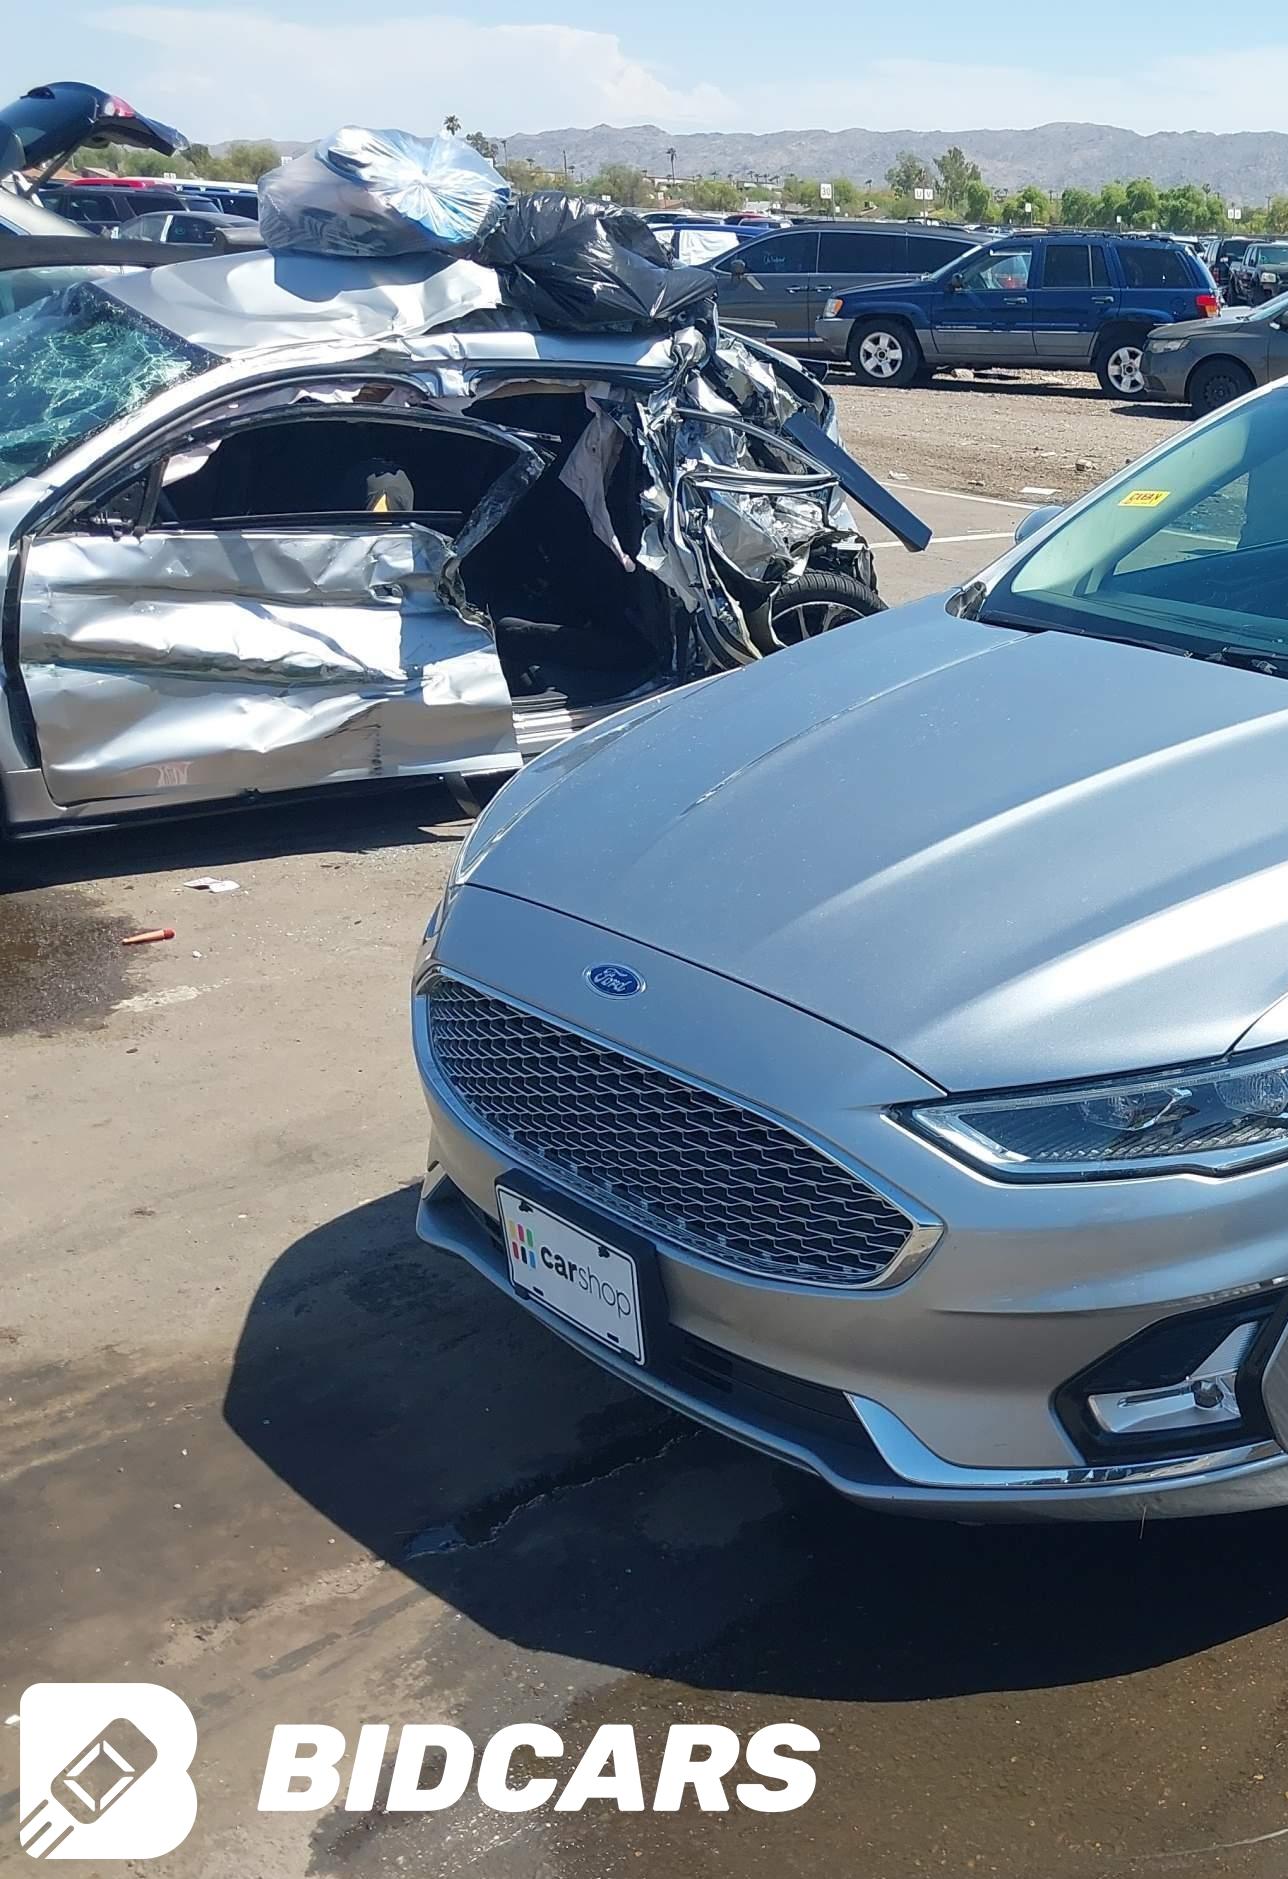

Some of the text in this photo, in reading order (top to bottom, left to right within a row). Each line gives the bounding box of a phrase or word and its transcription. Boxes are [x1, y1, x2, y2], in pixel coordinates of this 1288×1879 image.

[821, 186, 831, 197] 30
[593, 967, 633, 992] Ford
[540, 1246, 632, 1319] carshop
